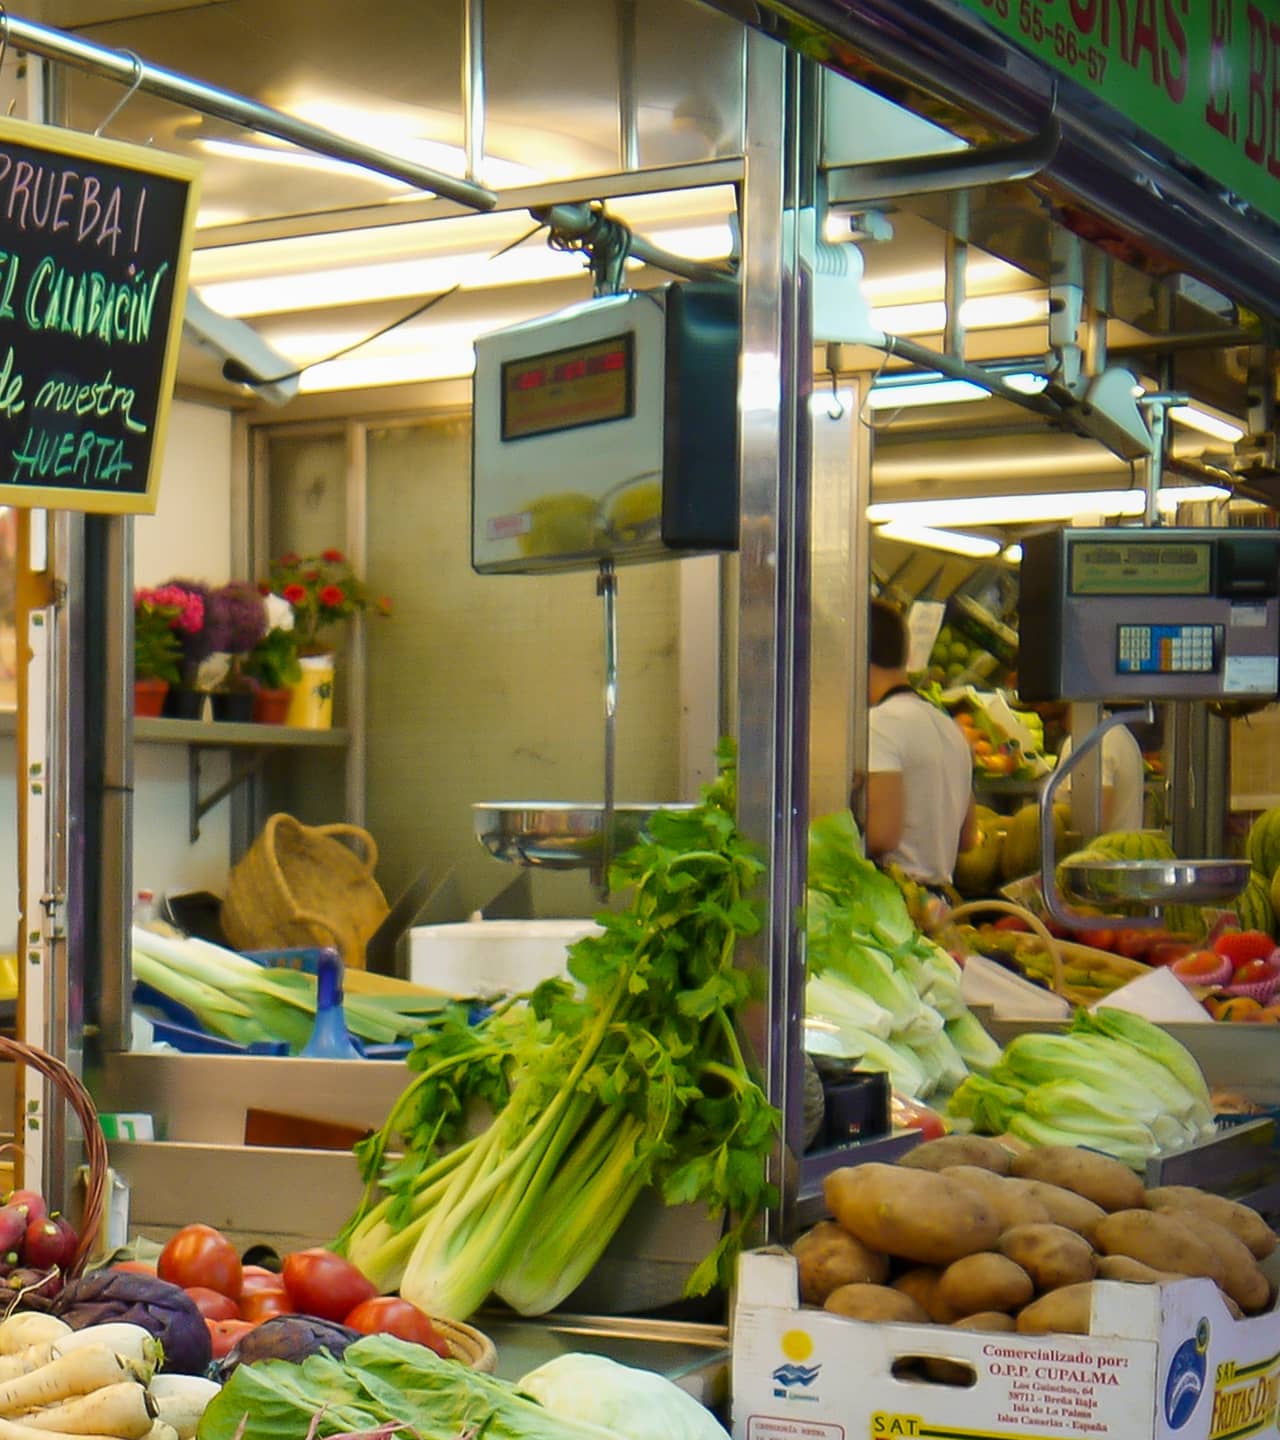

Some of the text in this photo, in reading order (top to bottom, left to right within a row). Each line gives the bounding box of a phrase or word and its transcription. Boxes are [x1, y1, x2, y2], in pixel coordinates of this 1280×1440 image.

[35, 371, 148, 433] nuestra
[11, 427, 133, 484] HUERTA
[983, 1344, 1129, 1369] Comercializado por:
[1035, 1367, 1120, 1386] CUPALMA
